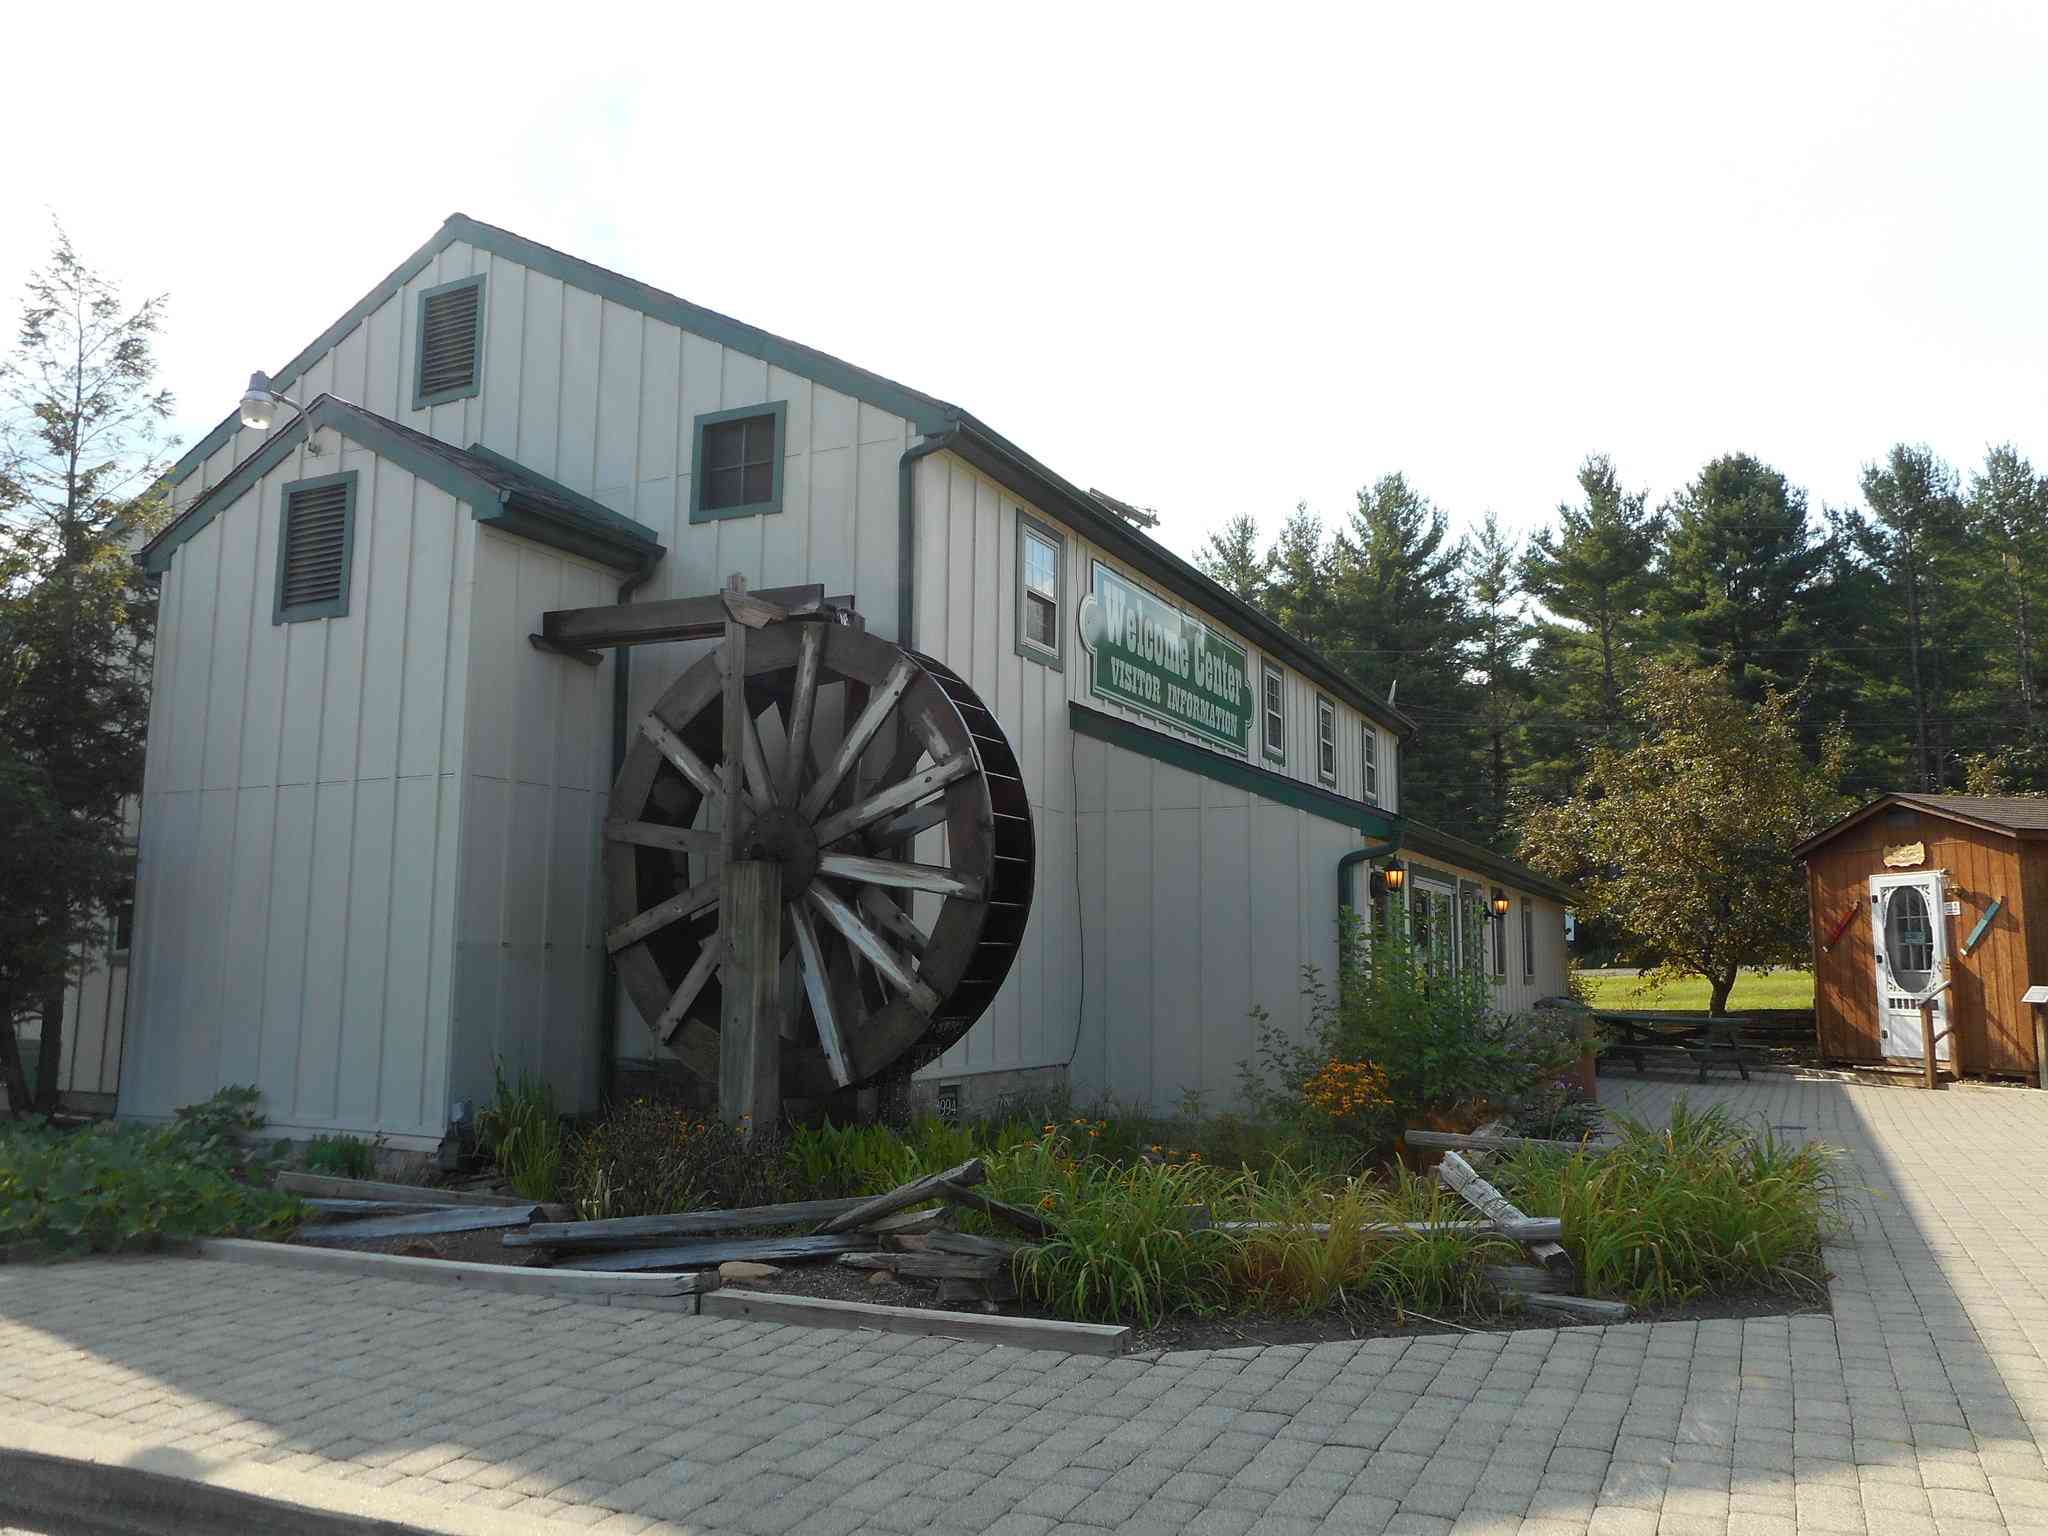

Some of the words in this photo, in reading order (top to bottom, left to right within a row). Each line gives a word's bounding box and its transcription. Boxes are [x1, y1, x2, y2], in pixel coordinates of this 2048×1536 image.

[1104, 580, 1189, 680] Welcome
[1194, 631, 1242, 706] Center
[1111, 656, 1161, 703] VISITOR
[1168, 683, 1238, 737] INFORMATION
